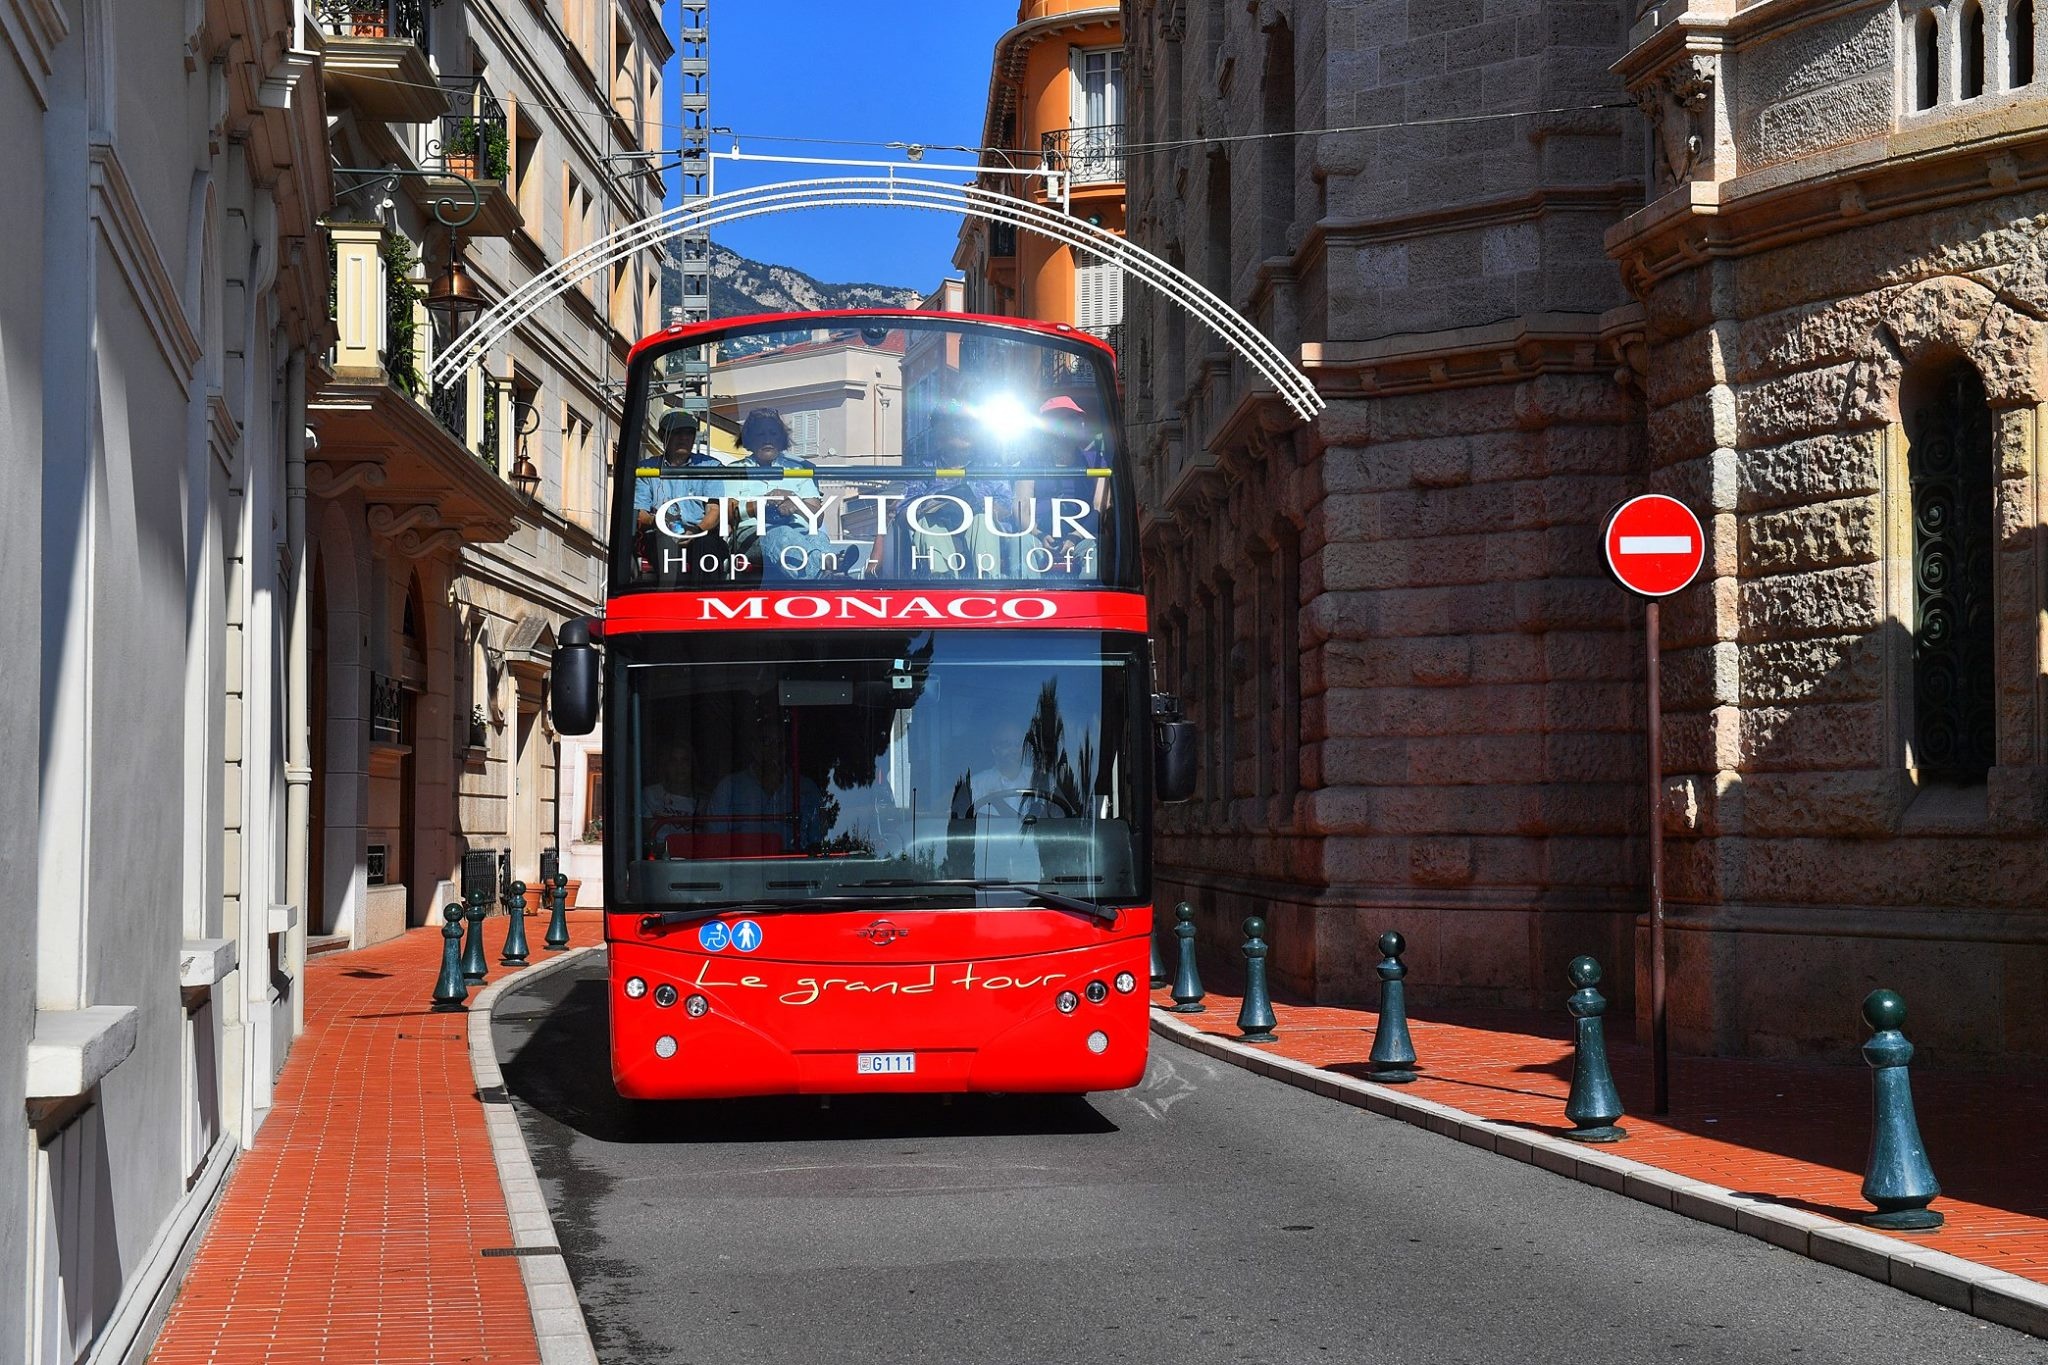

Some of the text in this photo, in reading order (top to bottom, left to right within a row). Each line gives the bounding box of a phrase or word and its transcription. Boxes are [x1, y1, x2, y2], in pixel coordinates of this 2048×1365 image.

[655, 494, 1096, 540] CITY TOUR
[664, 547, 749, 580] Hop
[780, 545, 837, 571] On
[911, 545, 995, 580] Hop
[1025, 546, 1094, 573] Off
[697, 596, 1058, 620] MONACO
[695, 959, 1067, 1005] Le grand tour
[872, 1056, 911, 1072] G111
